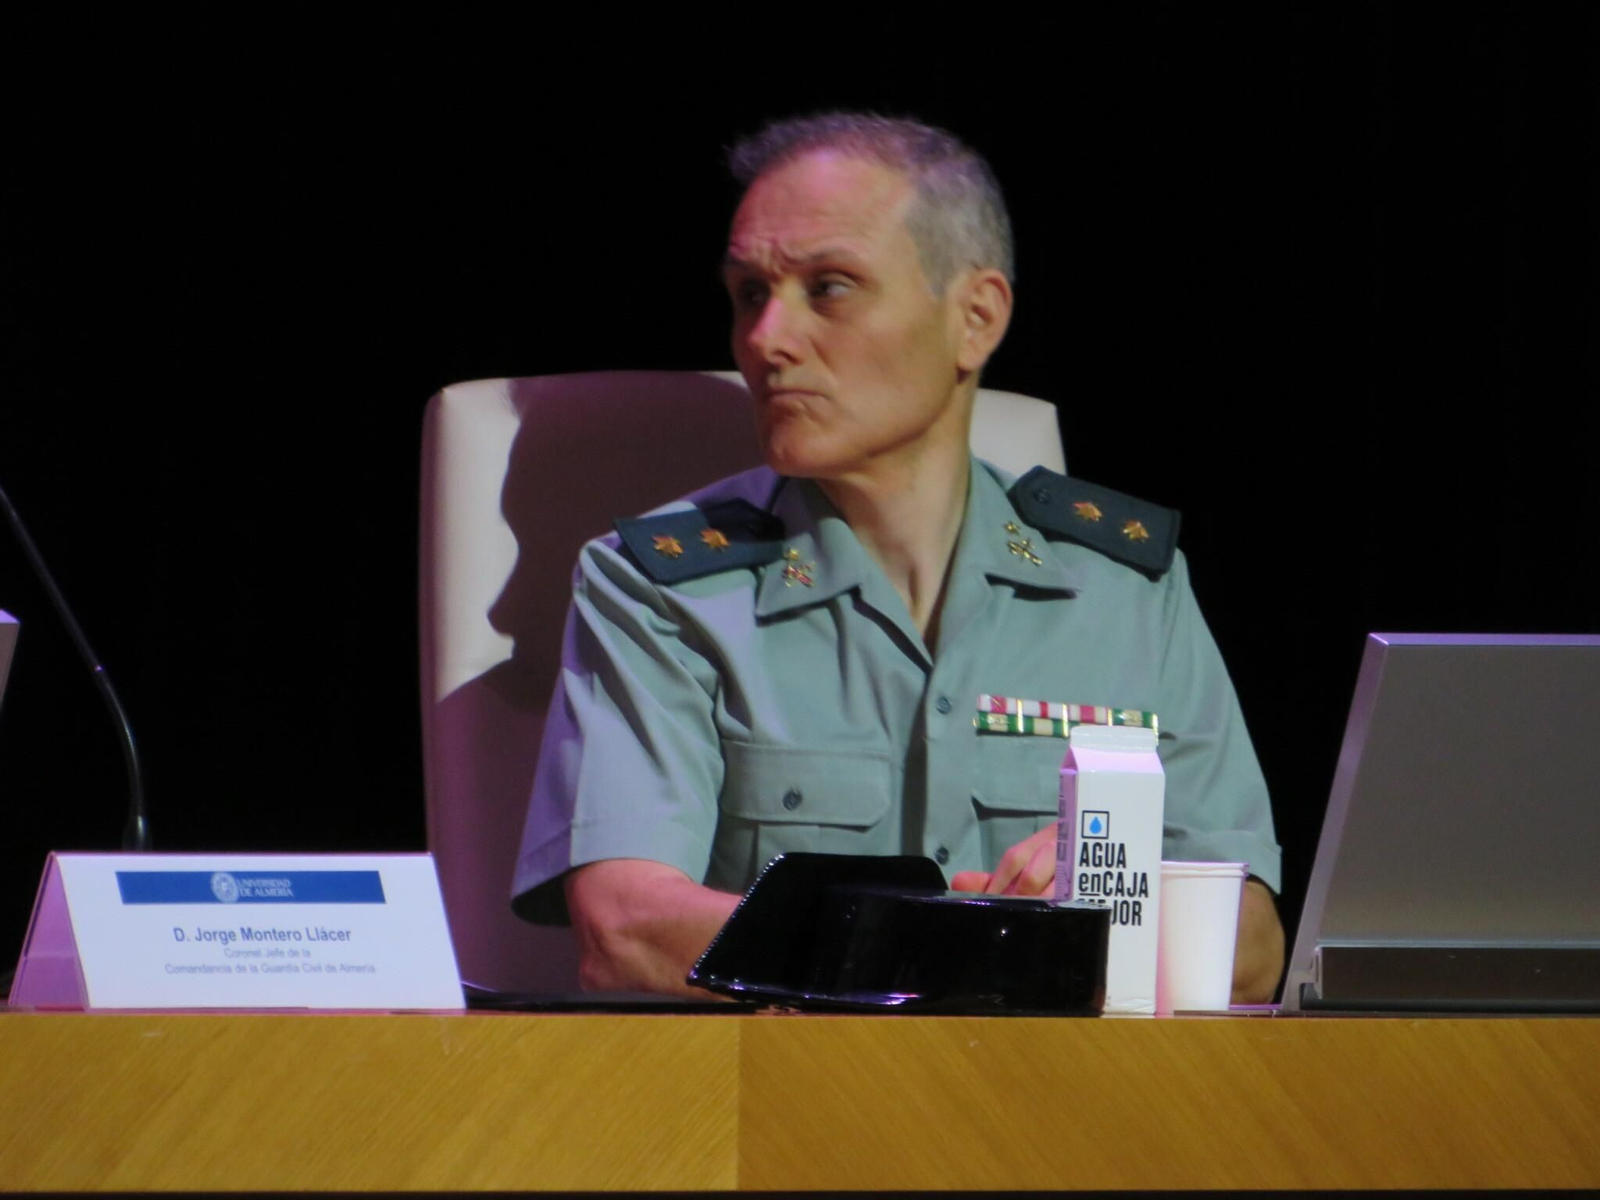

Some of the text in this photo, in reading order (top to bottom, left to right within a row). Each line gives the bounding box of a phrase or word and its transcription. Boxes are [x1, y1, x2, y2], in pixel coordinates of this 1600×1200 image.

[1079, 842, 1127, 868] AGUA
[236, 879, 292, 888] UNIVERSIDAD
[1079, 871, 1149, 898] enCAJA
[240, 888, 253, 897] DE
[1078, 898, 1142, 926] JOR
[173, 926, 351, 945] D. Jorge Montero Llácer
[224, 948, 311, 959] Coronel Jefe de la
[164, 963, 233, 974] Comandancia
[235, 963, 247, 974] de
[249, 963, 259, 974] la
[301, 963, 322, 974] Civil
[324, 963, 337, 974] de
